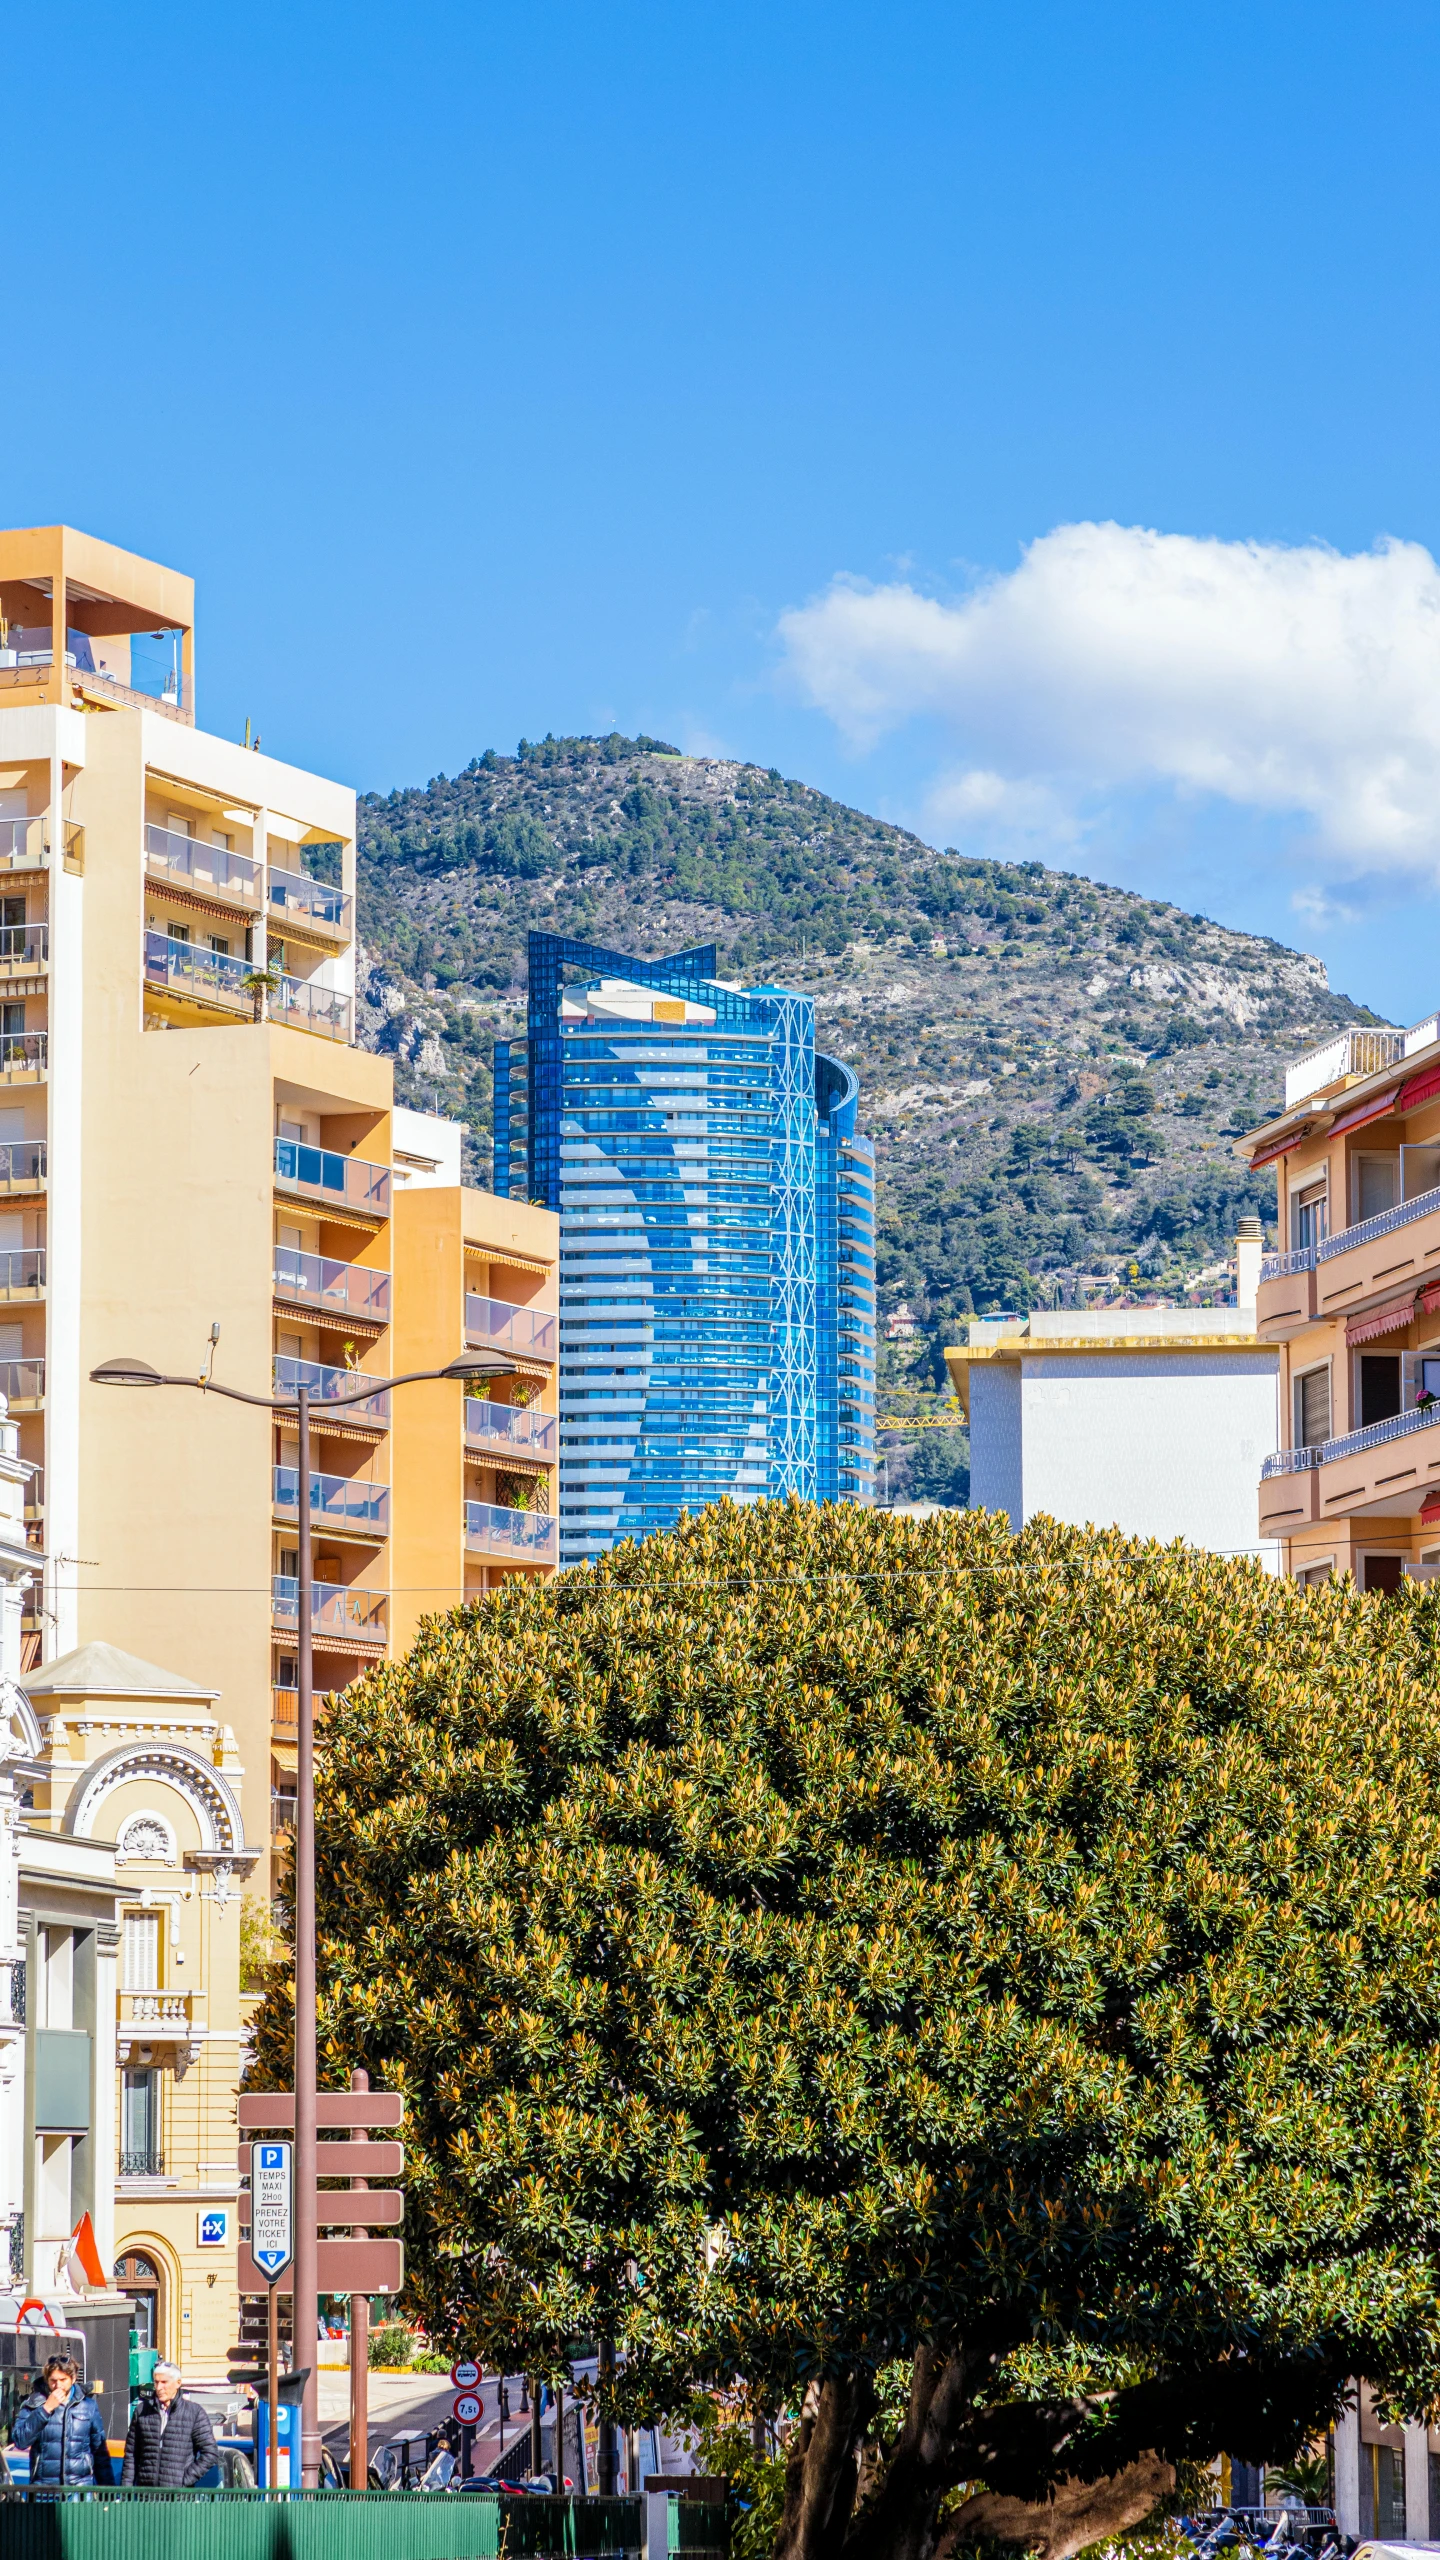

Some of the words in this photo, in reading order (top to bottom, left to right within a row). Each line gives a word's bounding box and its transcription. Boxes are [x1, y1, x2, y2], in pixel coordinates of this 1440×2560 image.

[266, 2150, 278, 2165] P
[258, 2172, 286, 2180] TEMPS
[261, 2182, 282, 2190] MAXI
[255, 2209, 288, 2217] PRENEZ
[258, 2219, 286, 2227] VOTRE
[257, 2229, 287, 2238] TICKET
[266, 2240, 278, 2248] ICI
